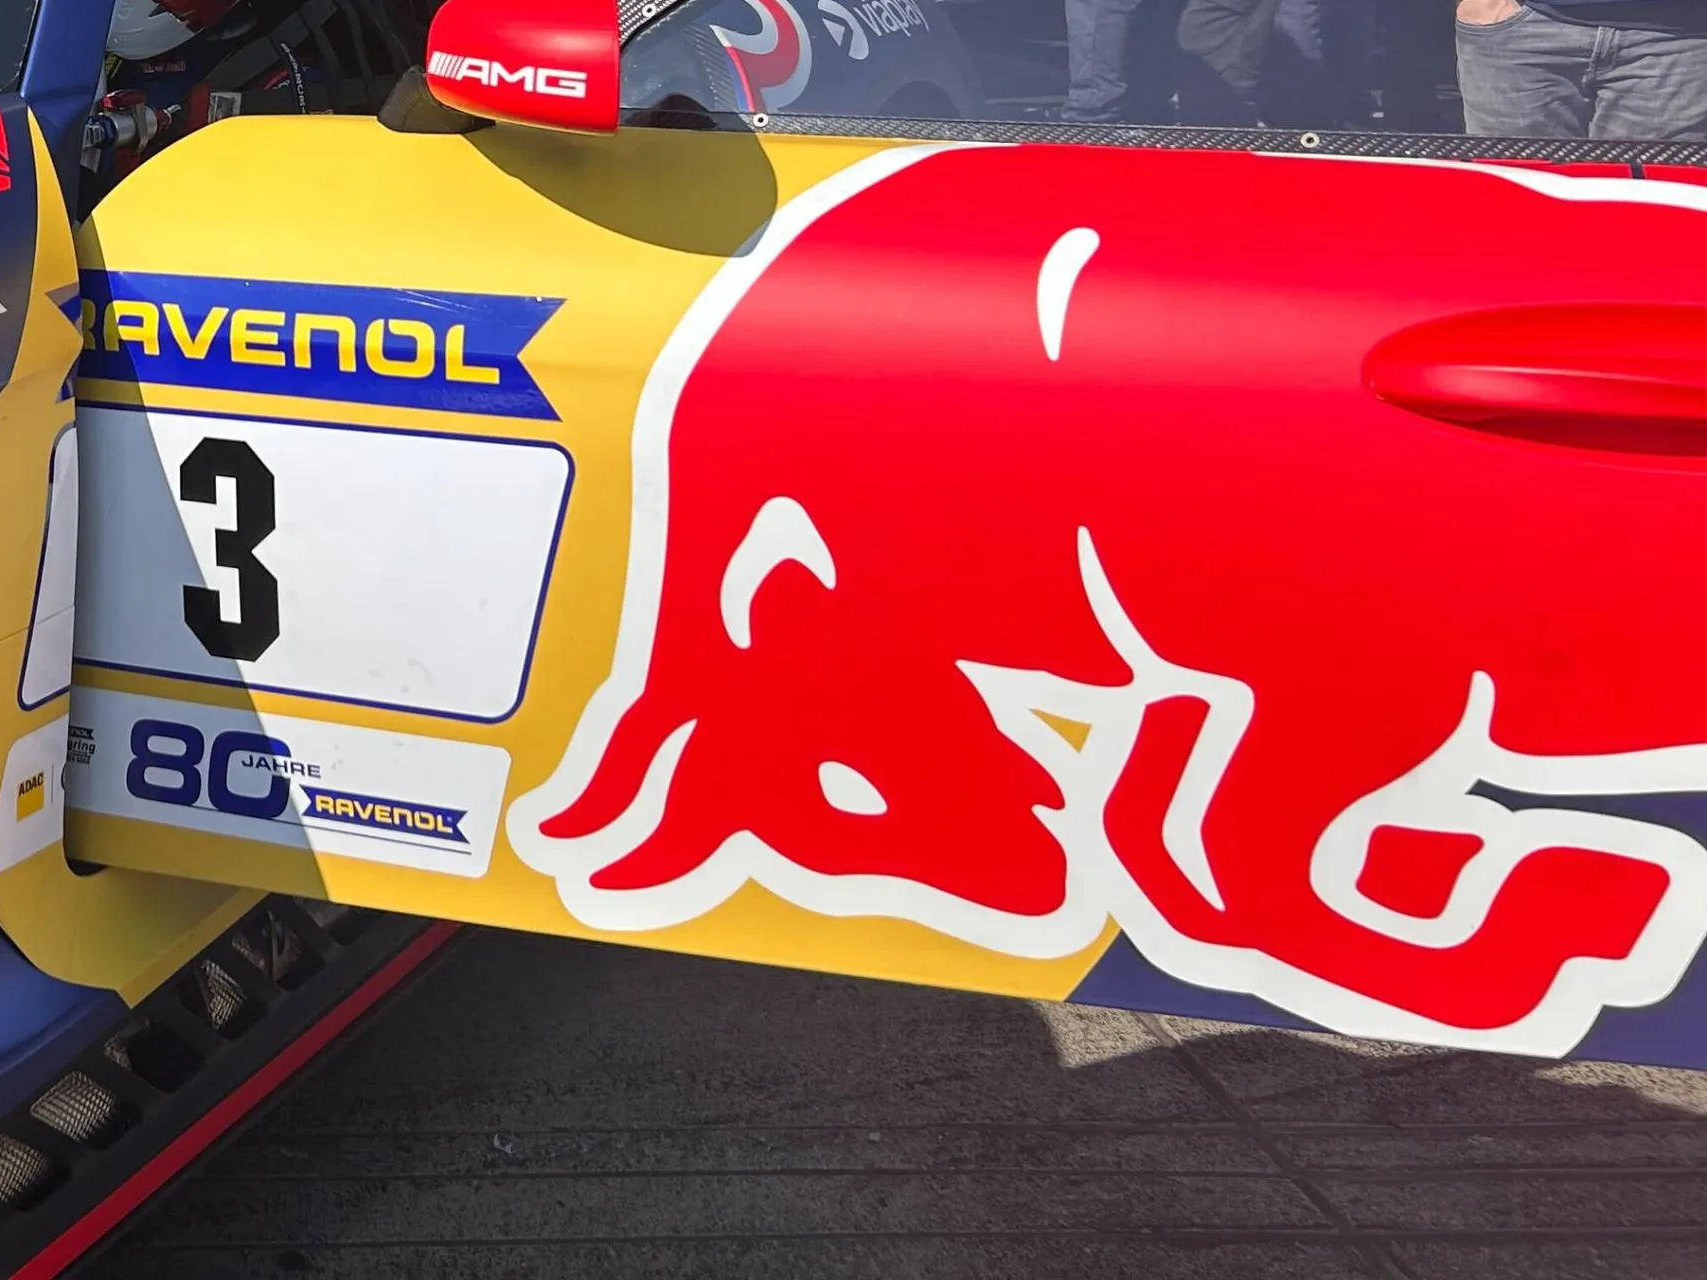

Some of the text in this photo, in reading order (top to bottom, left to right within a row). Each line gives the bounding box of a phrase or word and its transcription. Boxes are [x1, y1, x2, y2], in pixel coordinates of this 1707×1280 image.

[454, 56, 588, 98] AMG
[178, 436, 279, 662] 3
[18, 771, 45, 797] ADAC
[126, 718, 293, 820] 80
[241, 754, 322, 779] JAHRE
[315, 794, 455, 834] RAVENOL
